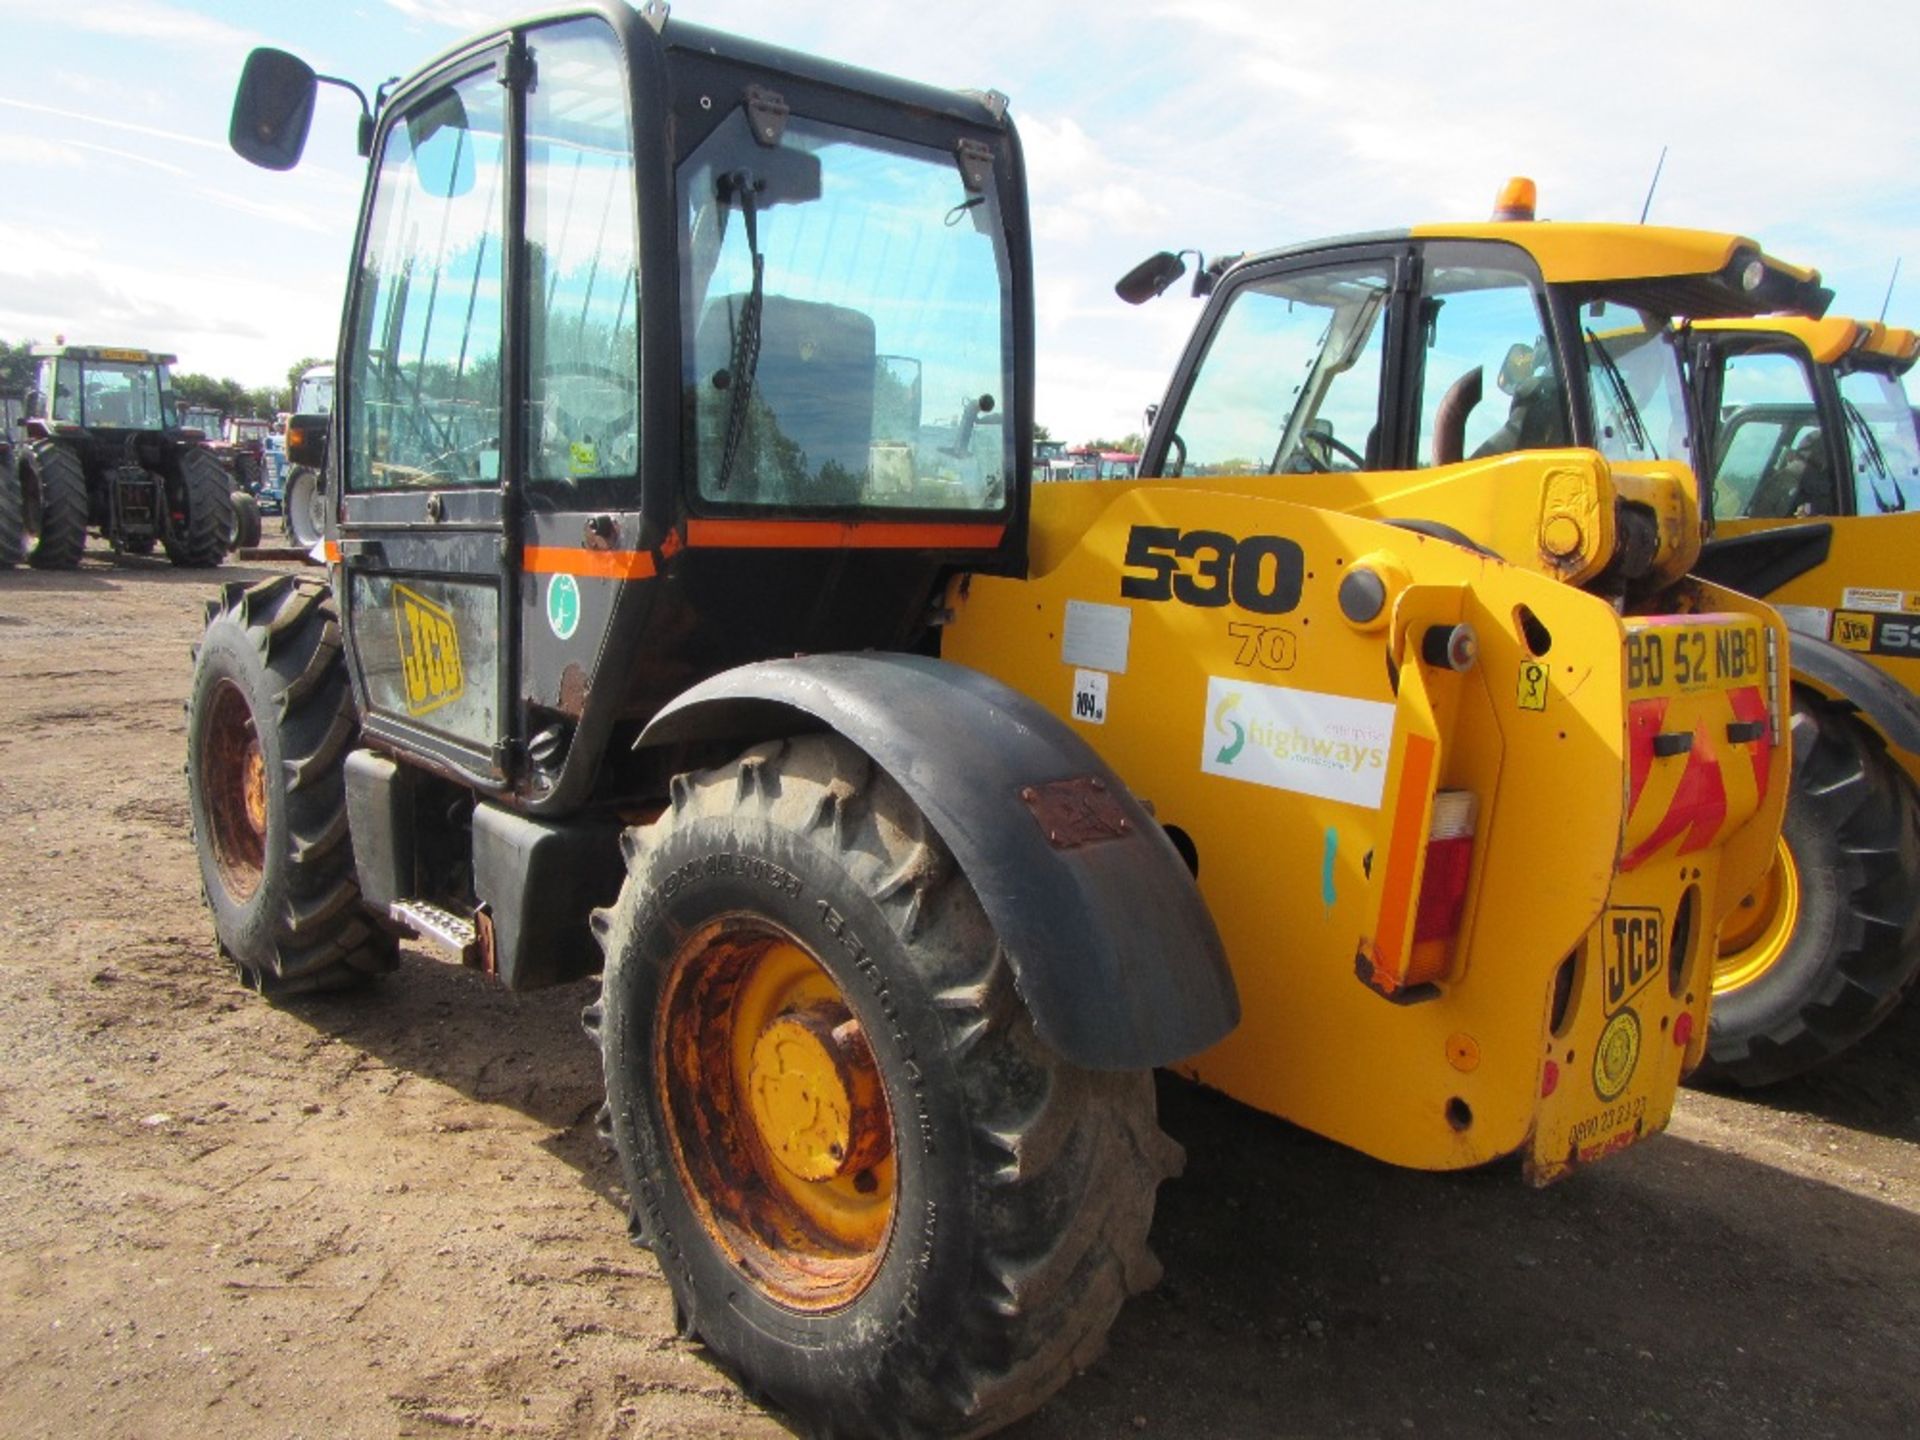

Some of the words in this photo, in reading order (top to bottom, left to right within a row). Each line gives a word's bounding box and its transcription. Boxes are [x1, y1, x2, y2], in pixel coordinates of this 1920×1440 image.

[1121, 525, 1304, 614] 530
[404, 600, 459, 701] JCB
[1228, 621, 1297, 671] 70
[1627, 634, 1663, 689] BD
[1674, 632, 1708, 684] 52
[1716, 627, 1758, 679] NBO
[1842, 620, 1868, 641] JCB
[1250, 717, 1383, 773] highways
[1609, 917, 1658, 1004] JCB
